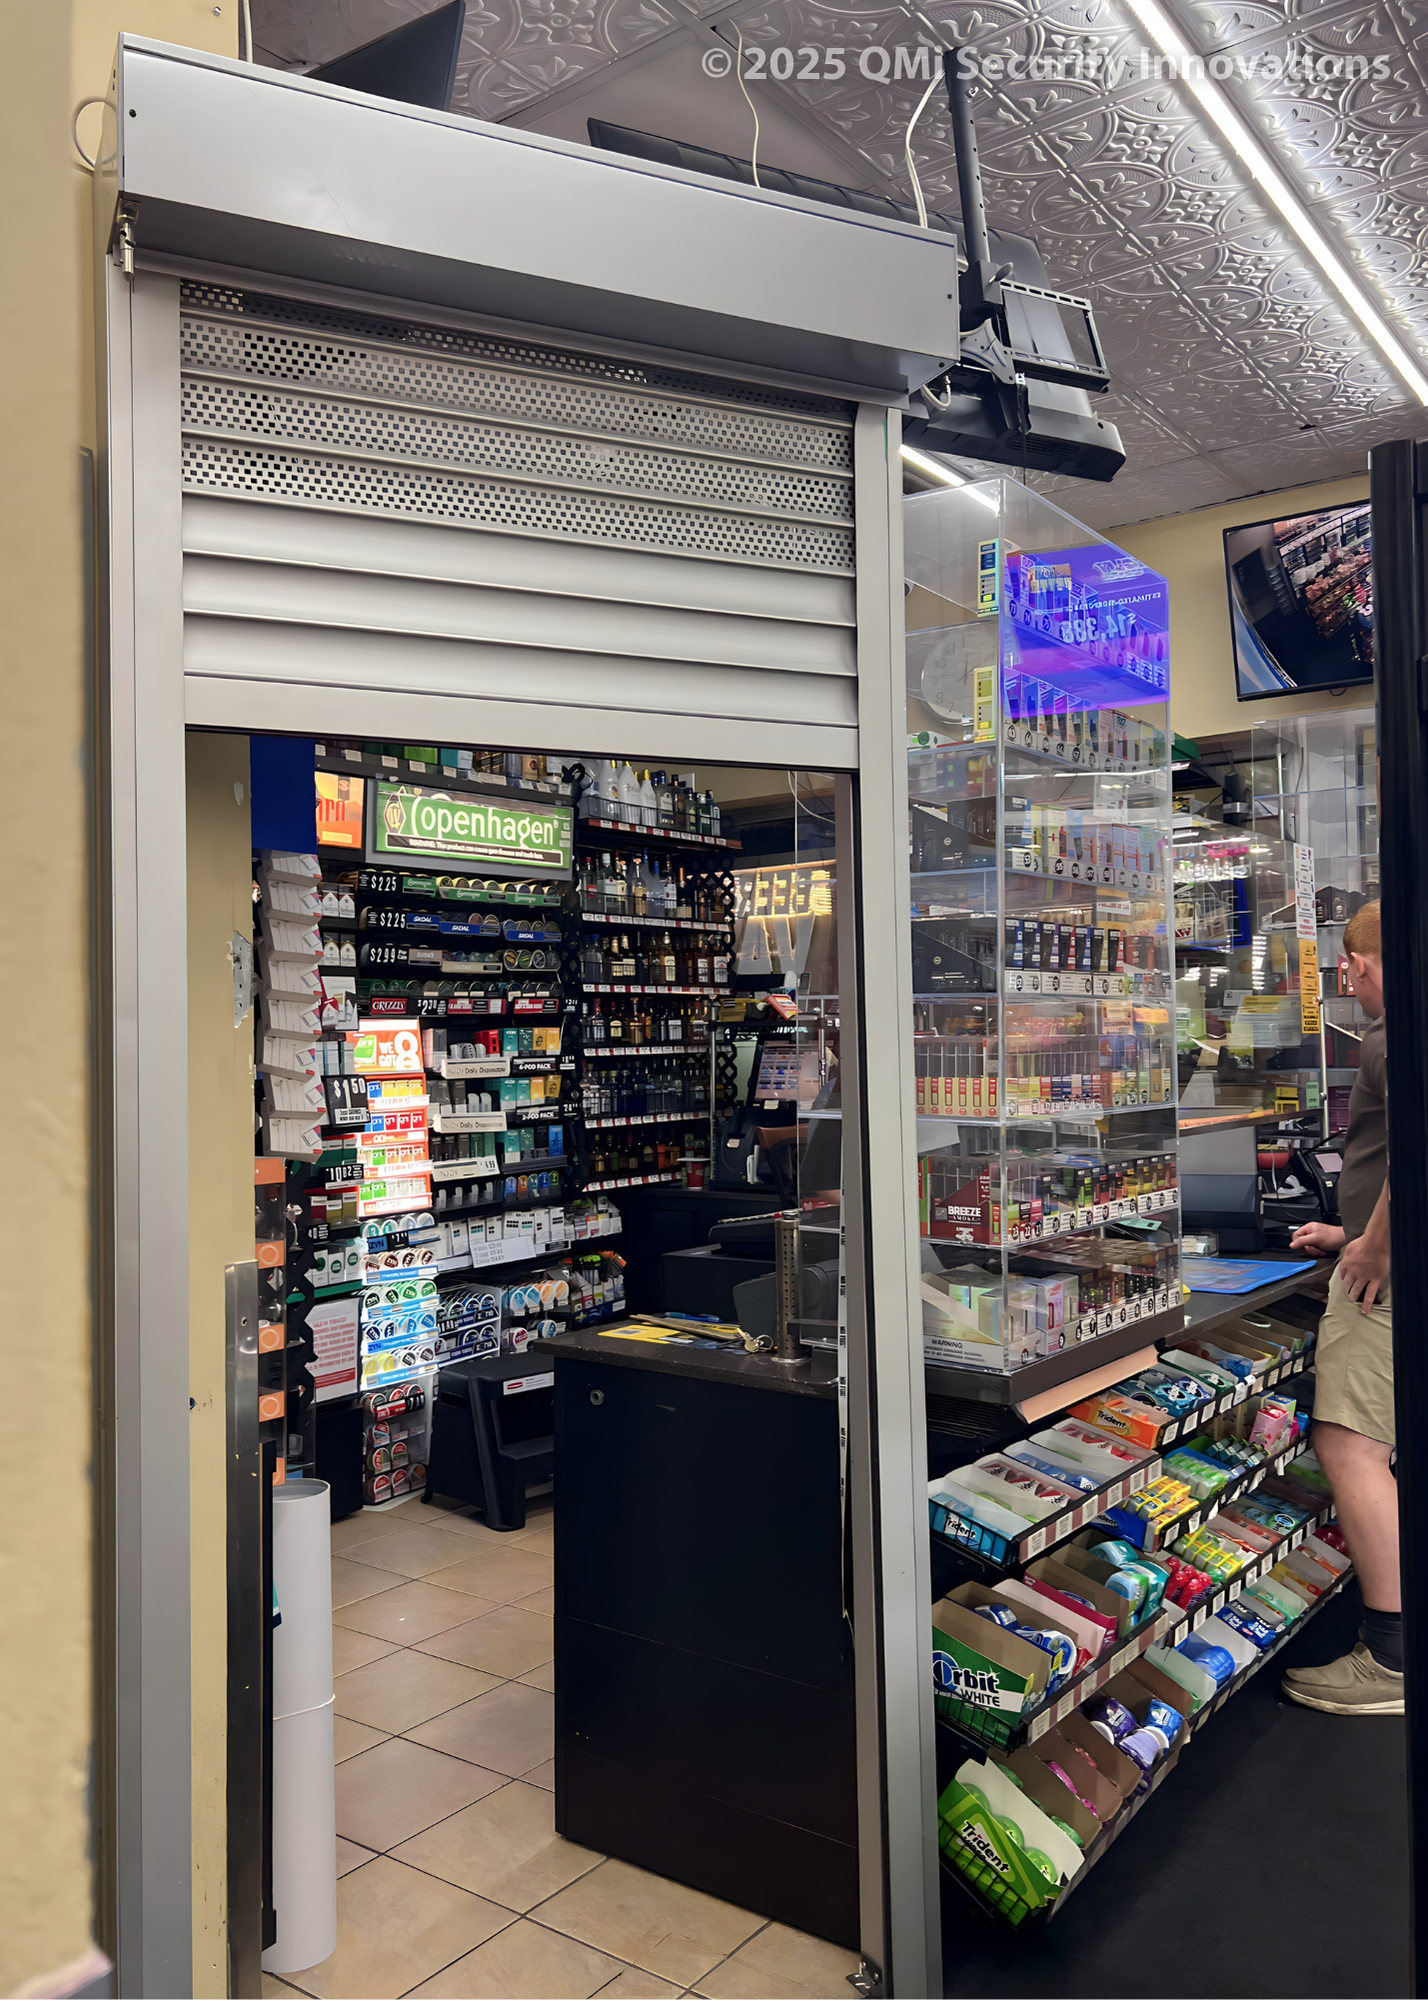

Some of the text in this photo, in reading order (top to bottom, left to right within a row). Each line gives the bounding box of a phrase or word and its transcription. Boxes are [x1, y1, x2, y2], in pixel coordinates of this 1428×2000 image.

[379, 1042, 394, 1053] WE
[394, 1031, 420, 1071] 8
[378, 1056, 397, 1067] GOT
[948, 1205, 981, 1217] BREEZE
[369, 1240, 385, 1249] ZYN
[1097, 1410, 1127, 1428] Trident
[945, 1515, 977, 1539] Trident
[932, 1650, 1000, 1694] Orbit
[960, 1688, 1000, 1707] WHITE
[961, 1820, 1010, 1872] Trident
